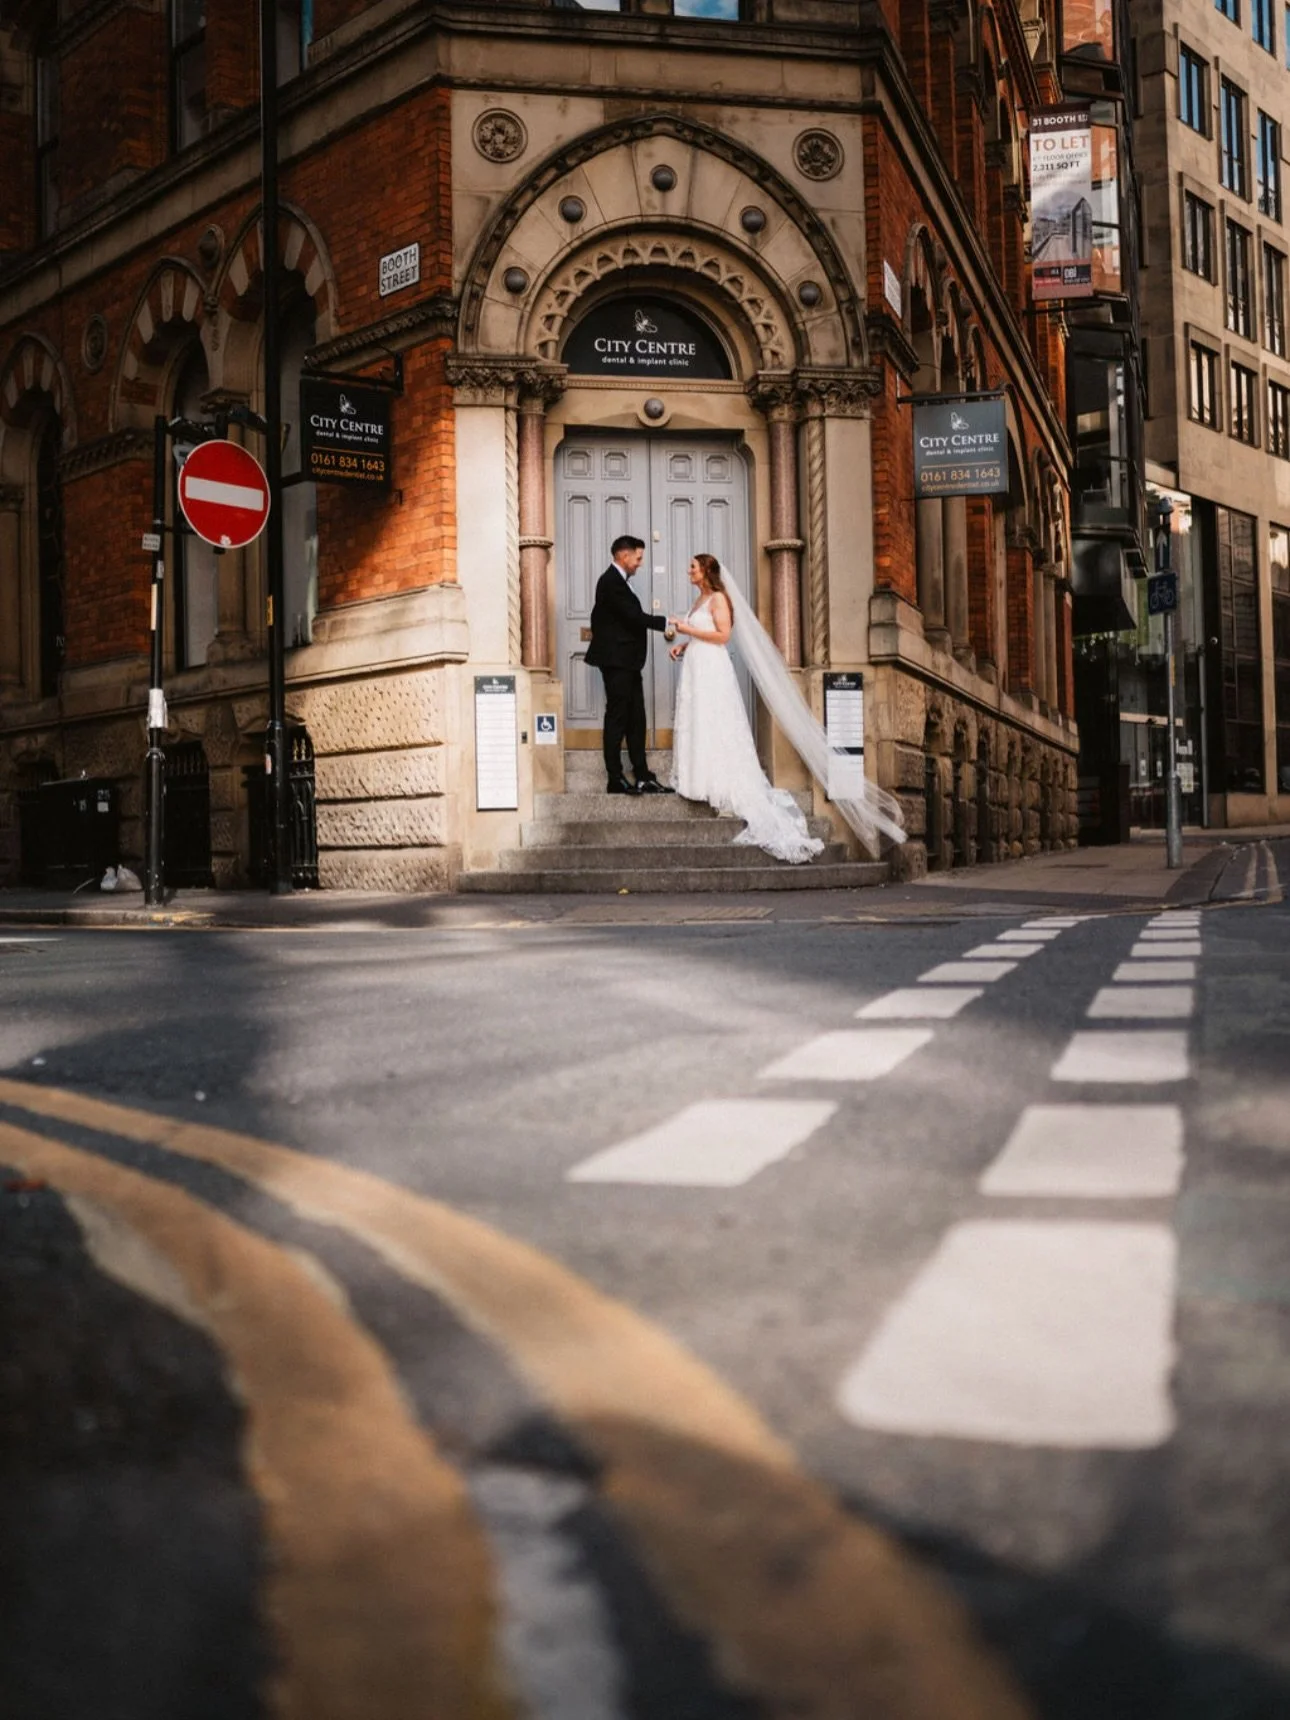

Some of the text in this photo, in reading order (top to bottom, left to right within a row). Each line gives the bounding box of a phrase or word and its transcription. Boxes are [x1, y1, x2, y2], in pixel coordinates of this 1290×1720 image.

[1043, 115, 1077, 126] BOOTH
[1033, 135, 1089, 152] TO LET
[1056, 162, 1068, 171] SQ
[1070, 160, 1080, 168] FT
[382, 247, 417, 275] BOOTH
[381, 265, 417, 293] STREET
[594, 337, 696, 356] CITY CENTRE
[601, 356, 689, 367] dental & implant clinic
[310, 414, 384, 436] CITY CENTRE
[920, 433, 1000, 449] CITY CENTRE
[925, 448, 945, 456] dental
[953, 447, 976, 455] implant
[310, 452, 385, 472] 0161 834 1643
[921, 467, 1000, 482] 0161 834 1643
